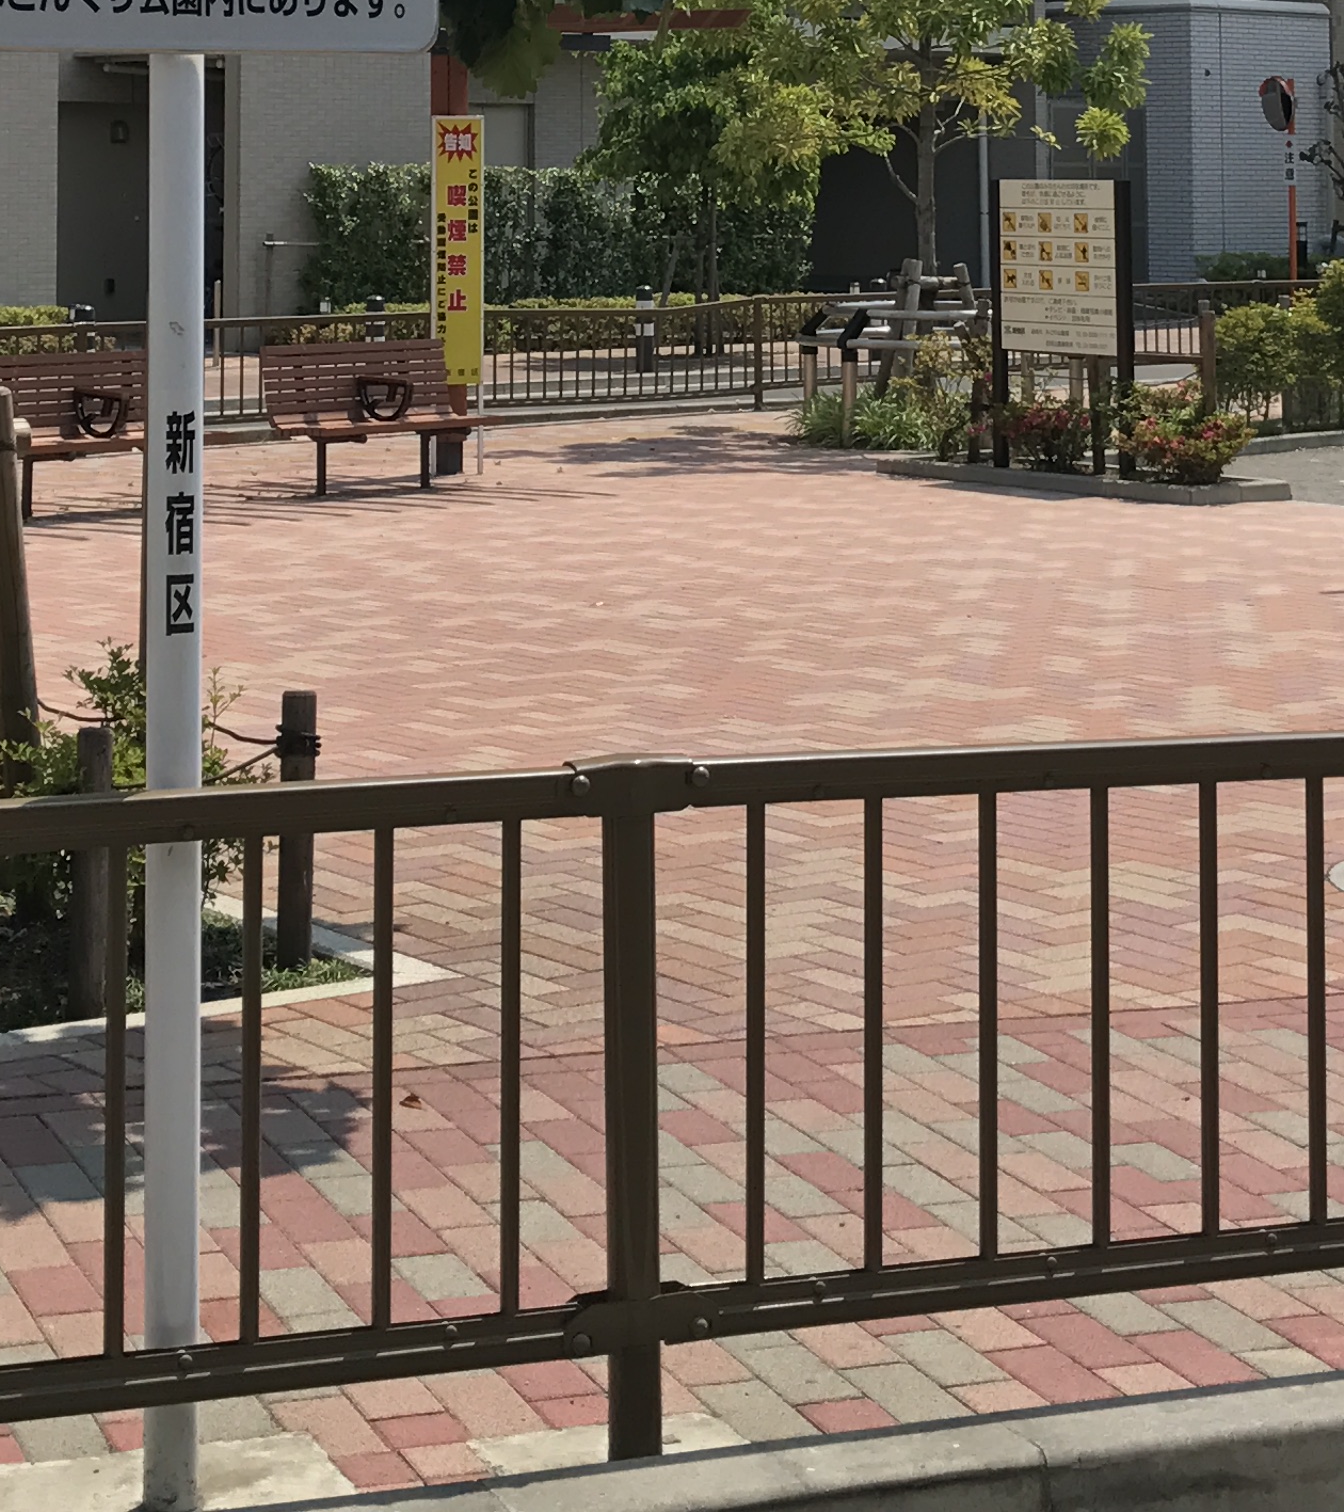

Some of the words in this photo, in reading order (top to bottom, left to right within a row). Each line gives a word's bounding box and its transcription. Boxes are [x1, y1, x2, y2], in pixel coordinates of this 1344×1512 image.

[447, 185, 467, 312] 喫煙禁止
[467, 168, 479, 234] この公園は
[165, 410, 195, 637] 新宿区
